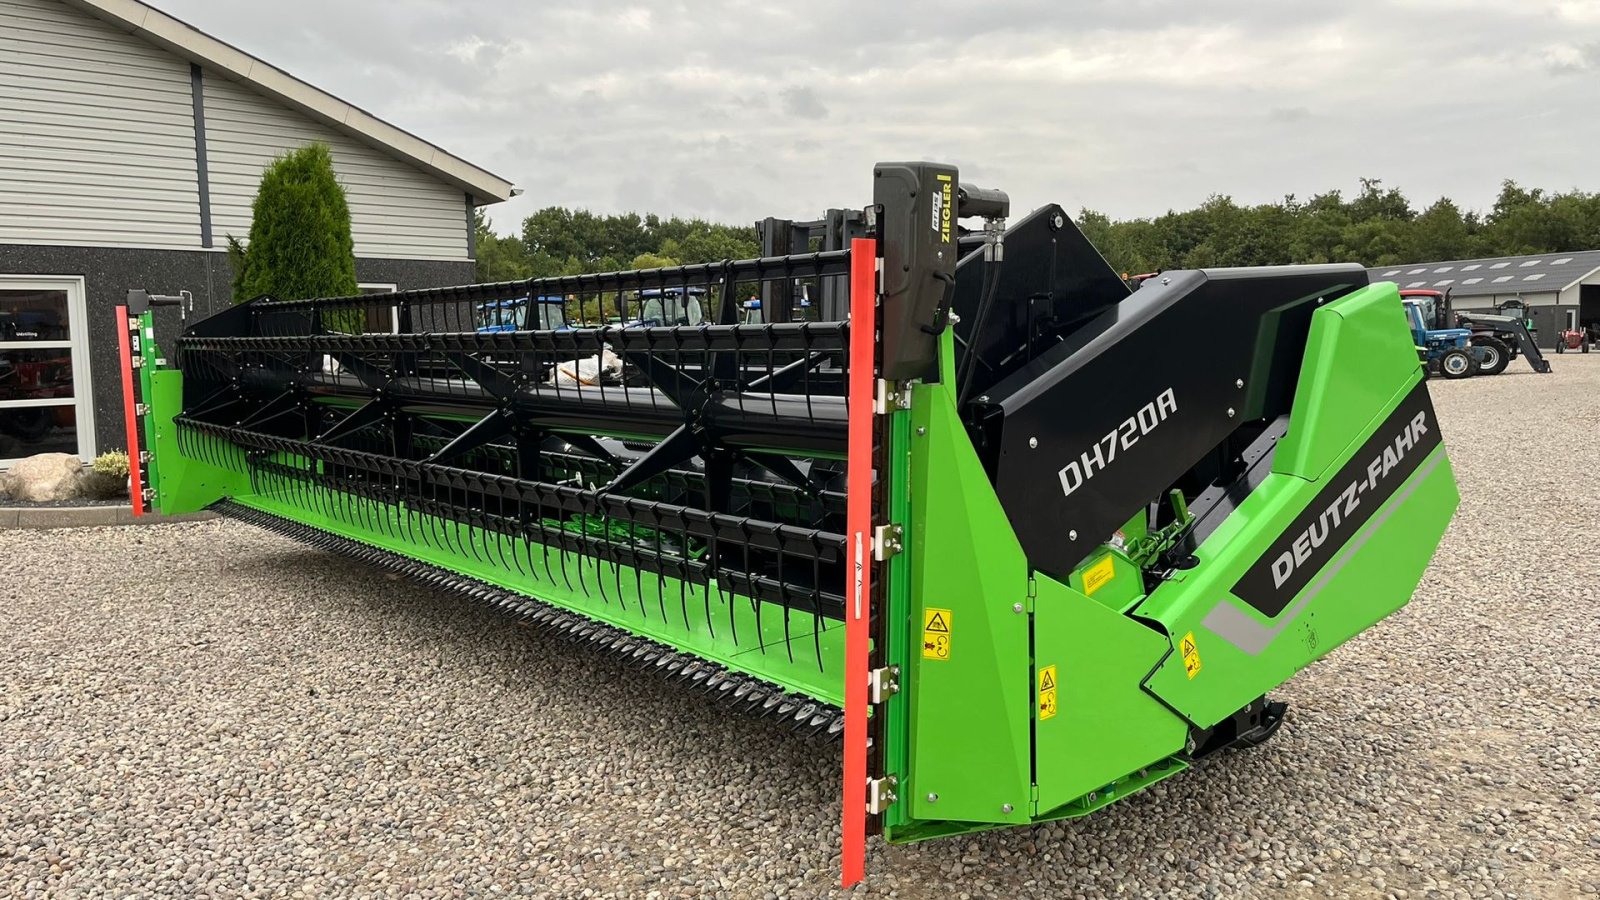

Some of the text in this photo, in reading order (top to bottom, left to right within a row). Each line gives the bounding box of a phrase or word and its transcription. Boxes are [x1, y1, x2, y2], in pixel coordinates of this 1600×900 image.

[942, 183, 951, 243] ZIEGLER
[1058, 387, 1178, 497] DH720A
[1271, 410, 1428, 590] DEUTZ-FAHR
